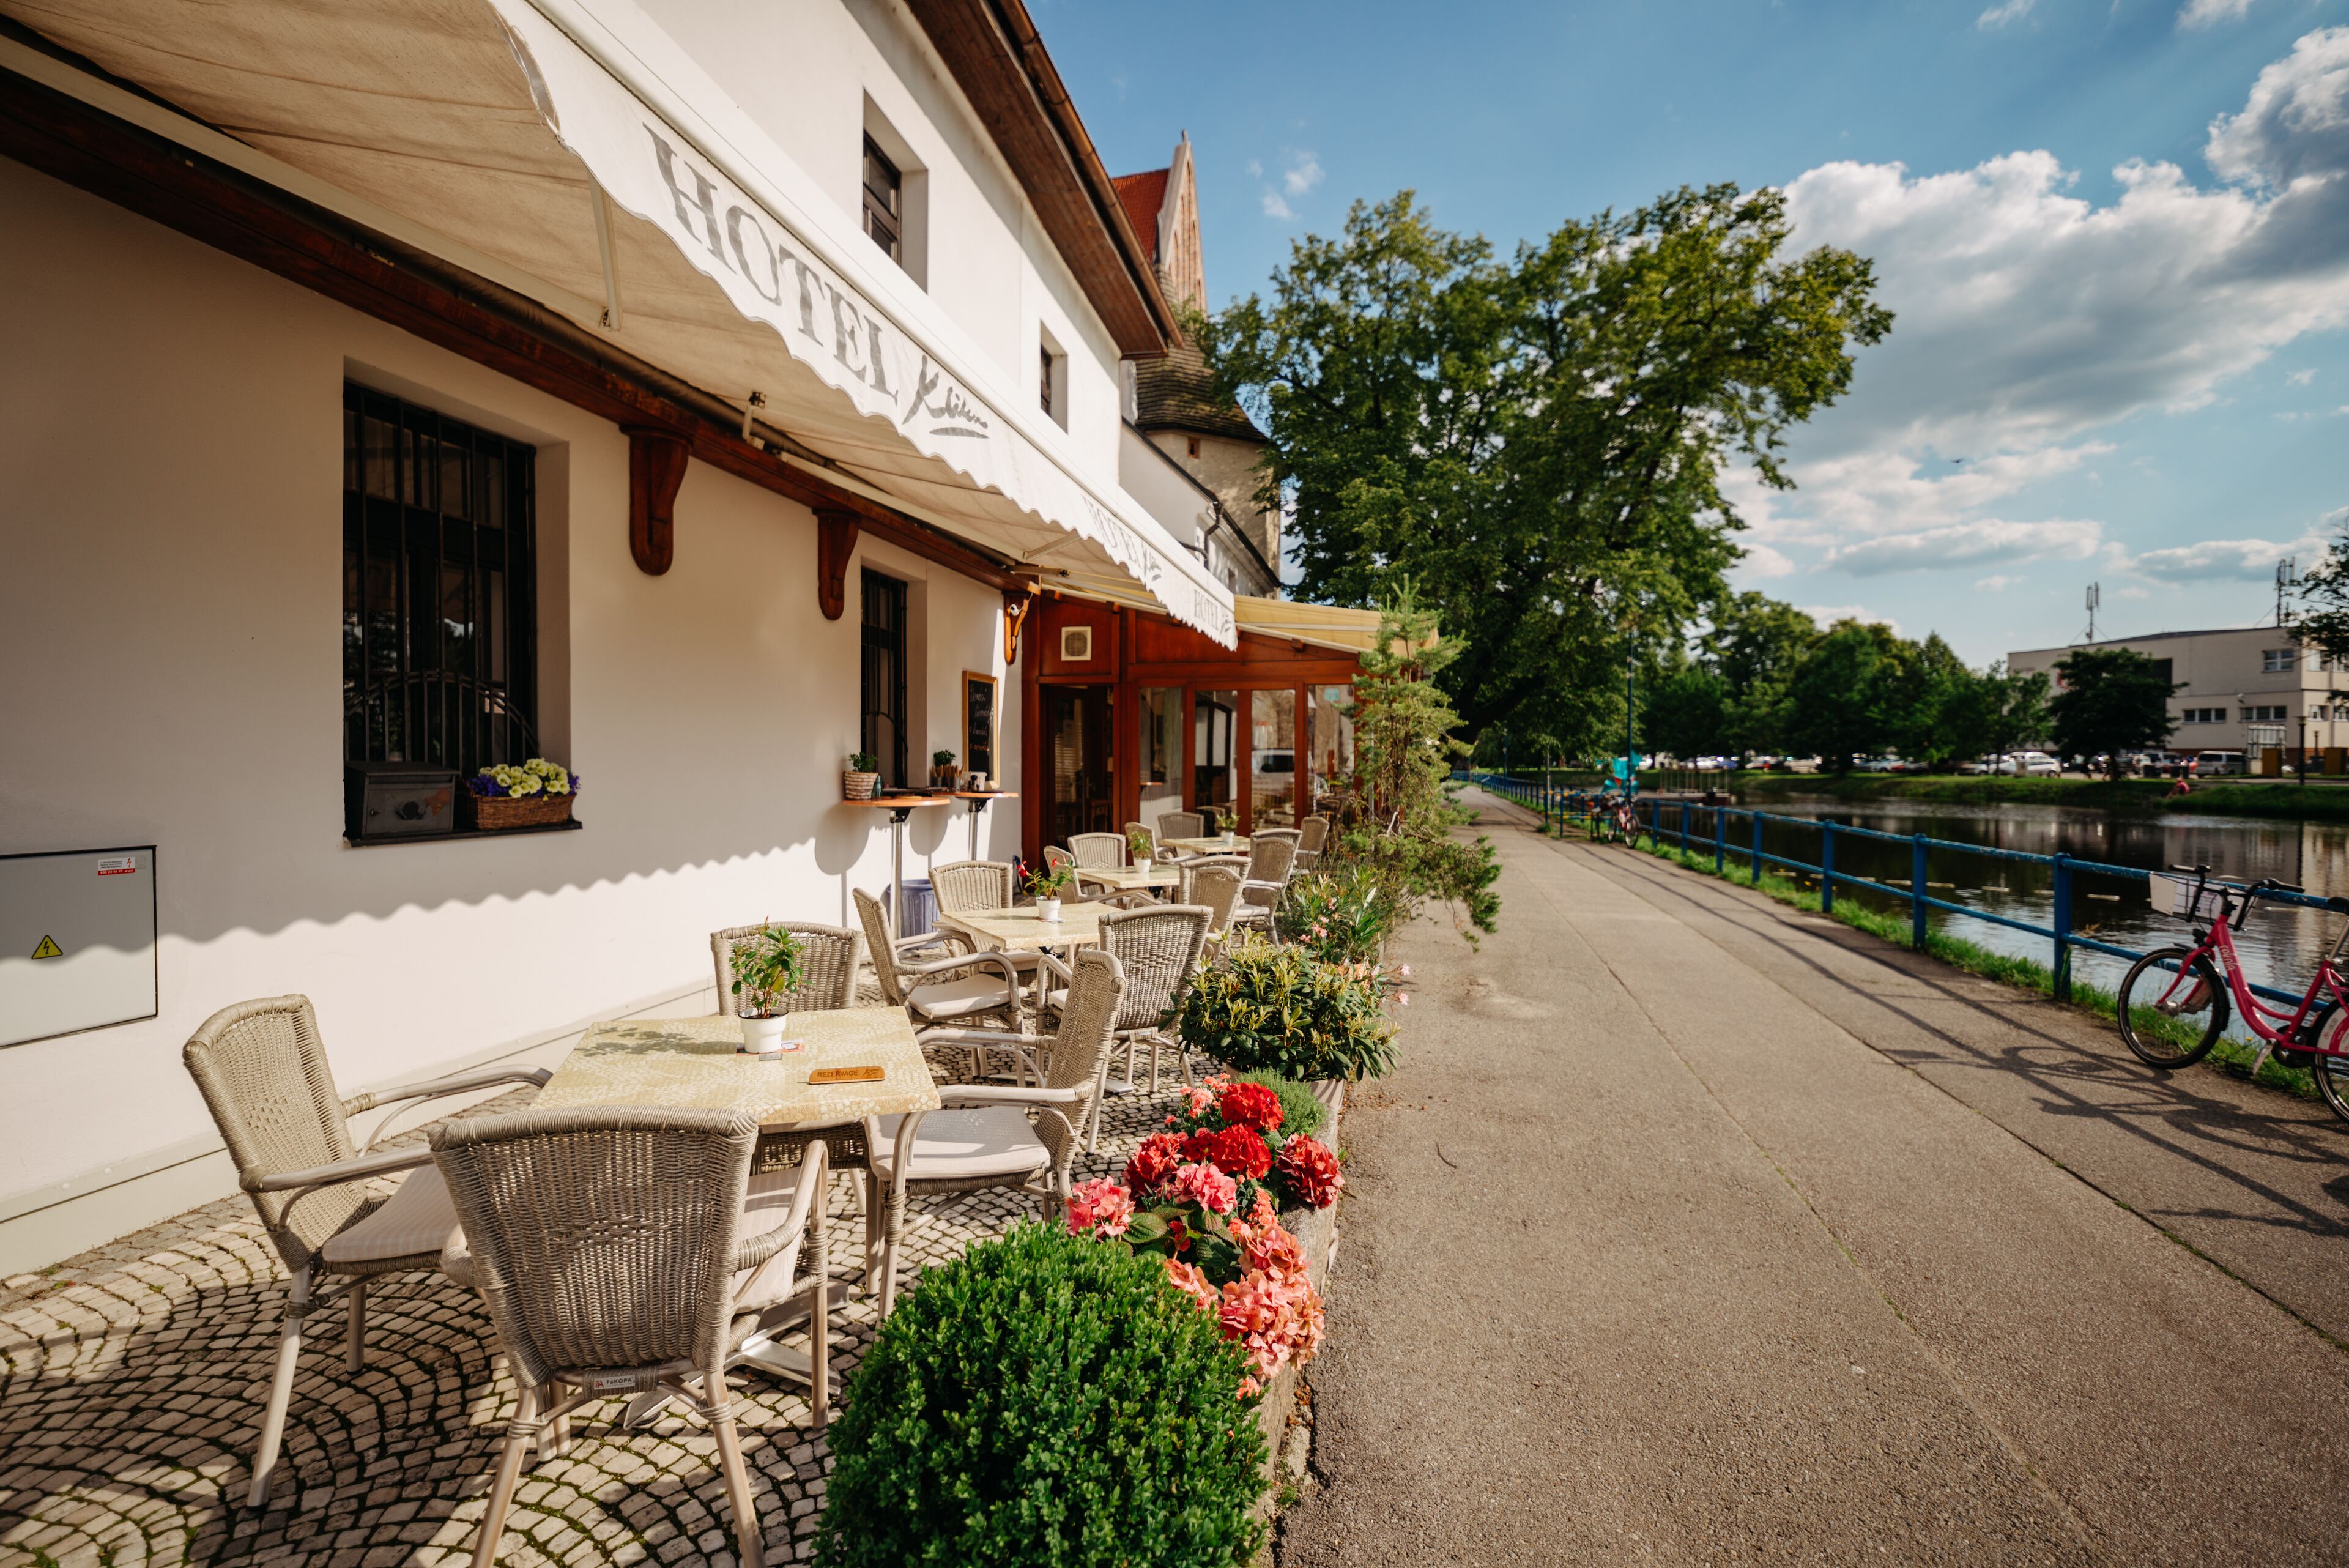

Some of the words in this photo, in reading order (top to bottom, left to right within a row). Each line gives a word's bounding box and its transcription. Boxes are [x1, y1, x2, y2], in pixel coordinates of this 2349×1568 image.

[642, 122, 899, 407] HOTEL
[1080, 494, 1143, 570] HOTEL
[1193, 589, 1219, 631] HOTEL
[2219, 945, 2240, 971] rekola
[817, 1069, 858, 1078] REZERVACE
